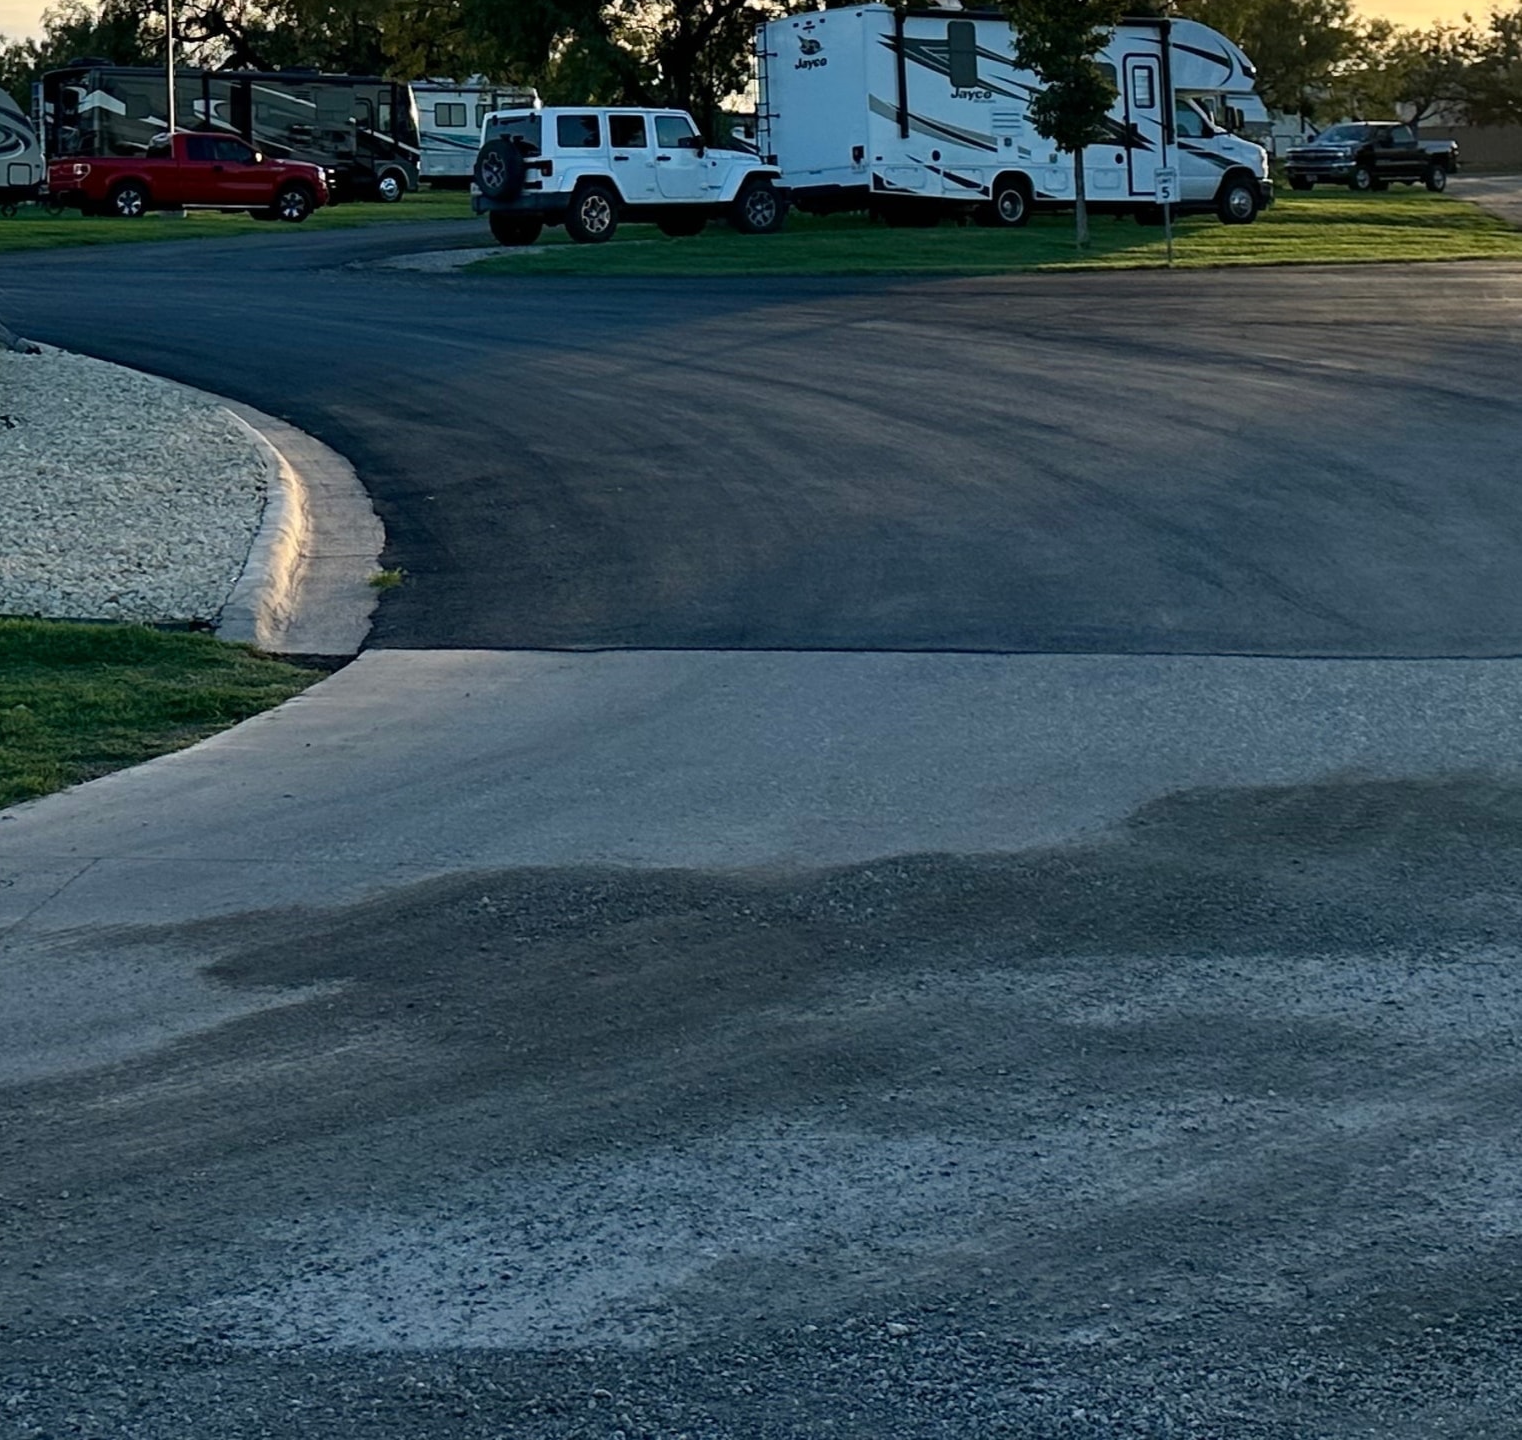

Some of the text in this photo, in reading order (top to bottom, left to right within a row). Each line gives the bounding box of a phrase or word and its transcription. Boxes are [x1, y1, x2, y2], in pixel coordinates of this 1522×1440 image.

[794, 58, 827, 70] Jayco
[950, 87, 992, 101] Jayco
[1162, 186, 1170, 199] 5
